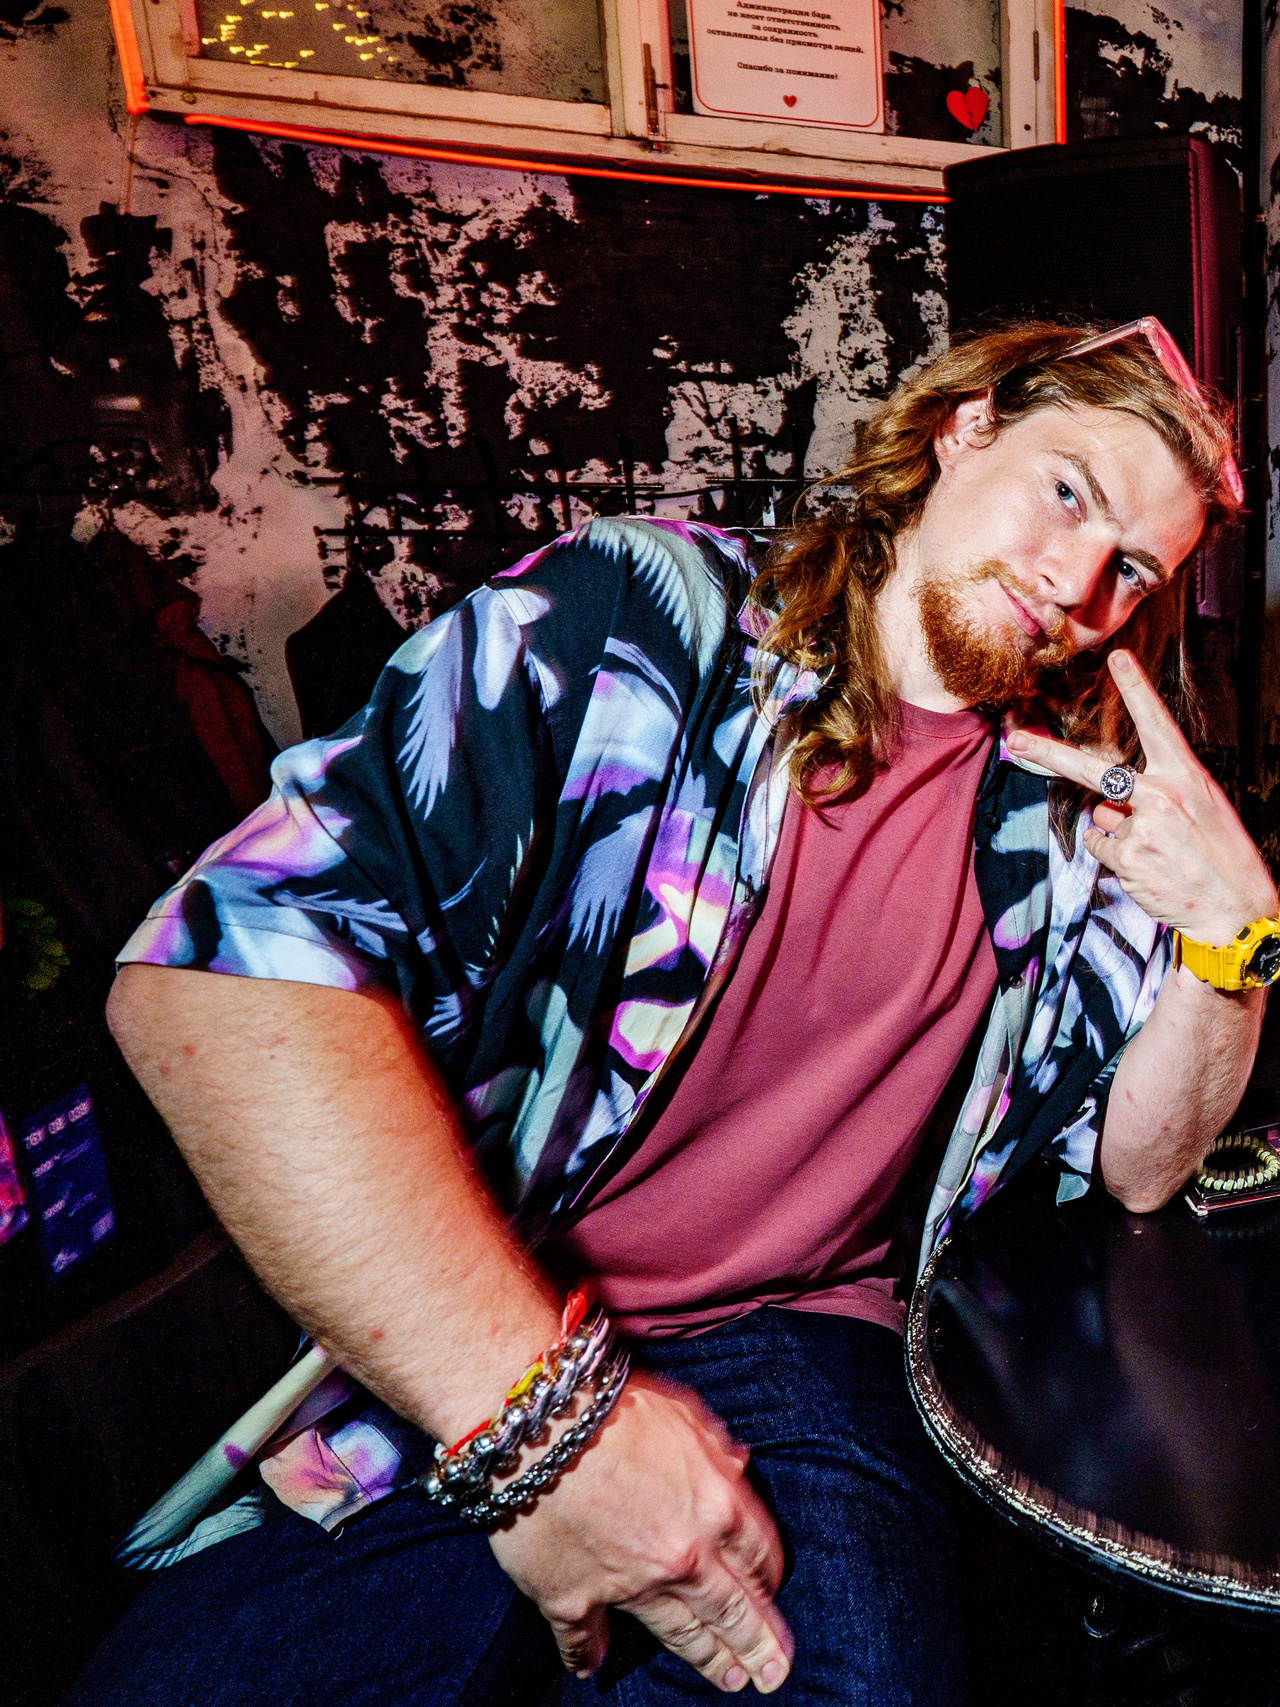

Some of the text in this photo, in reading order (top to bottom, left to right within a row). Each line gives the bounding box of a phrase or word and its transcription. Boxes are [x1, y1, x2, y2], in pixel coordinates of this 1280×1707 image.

[736, 0, 831, 20] Администрация бара
[727, 10, 841, 31] не несет ответственность
[706, 29, 864, 54] оставленных без присмотра вещей.
[763, 26, 818, 38] сохранность
[737, 62, 773, 73] Спасибо
[786, 68, 838, 80] понимание!
